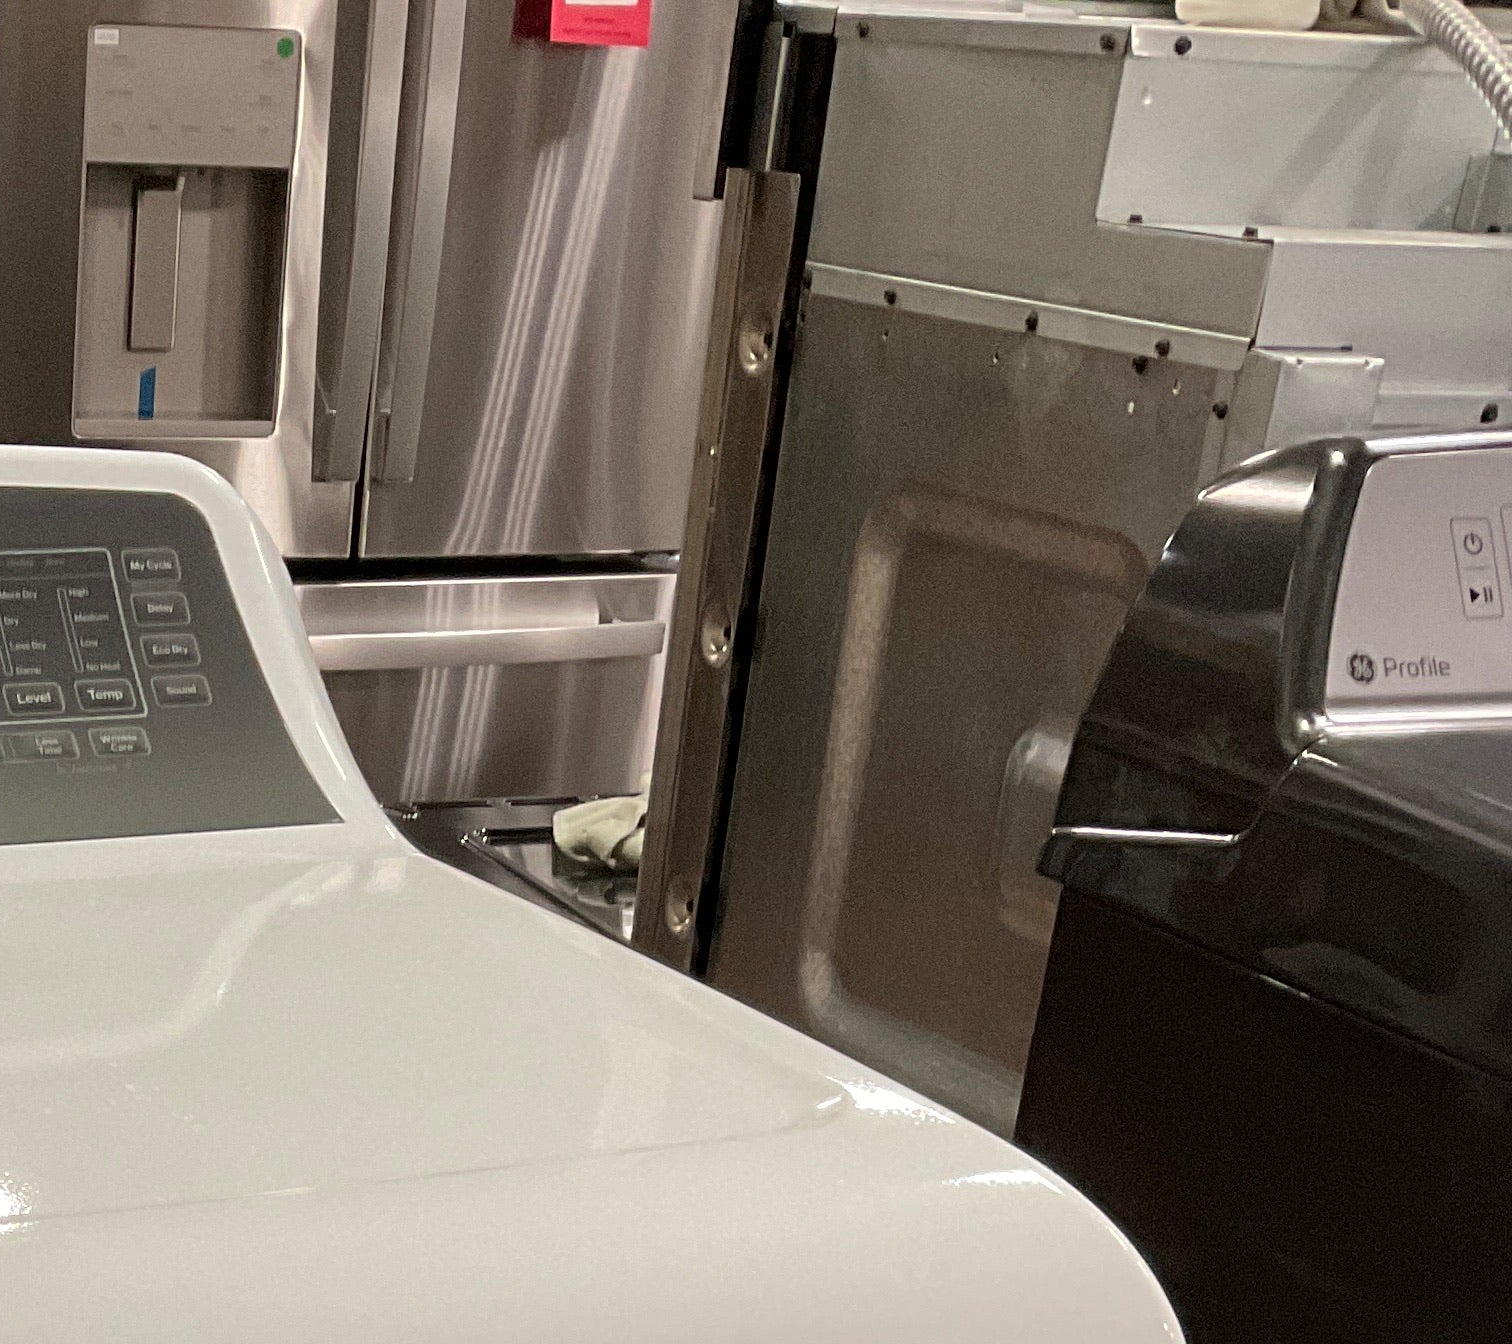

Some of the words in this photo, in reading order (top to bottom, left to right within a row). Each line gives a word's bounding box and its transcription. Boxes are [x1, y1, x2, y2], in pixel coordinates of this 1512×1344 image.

[130, 560, 145, 572] My
[146, 559, 172, 571] Cycle
[0, 590, 20, 600] More
[22, 590, 37, 600] Dry
[69, 588, 89, 599] High
[147, 603, 173, 614] Delay
[4, 616, 18, 626] Dry
[80, 637, 98, 648] Low
[172, 644, 188, 655] Dry
[1384, 656, 1451, 678] Profile
[17, 692, 51, 704] Level
[87, 688, 122, 701] Temp
